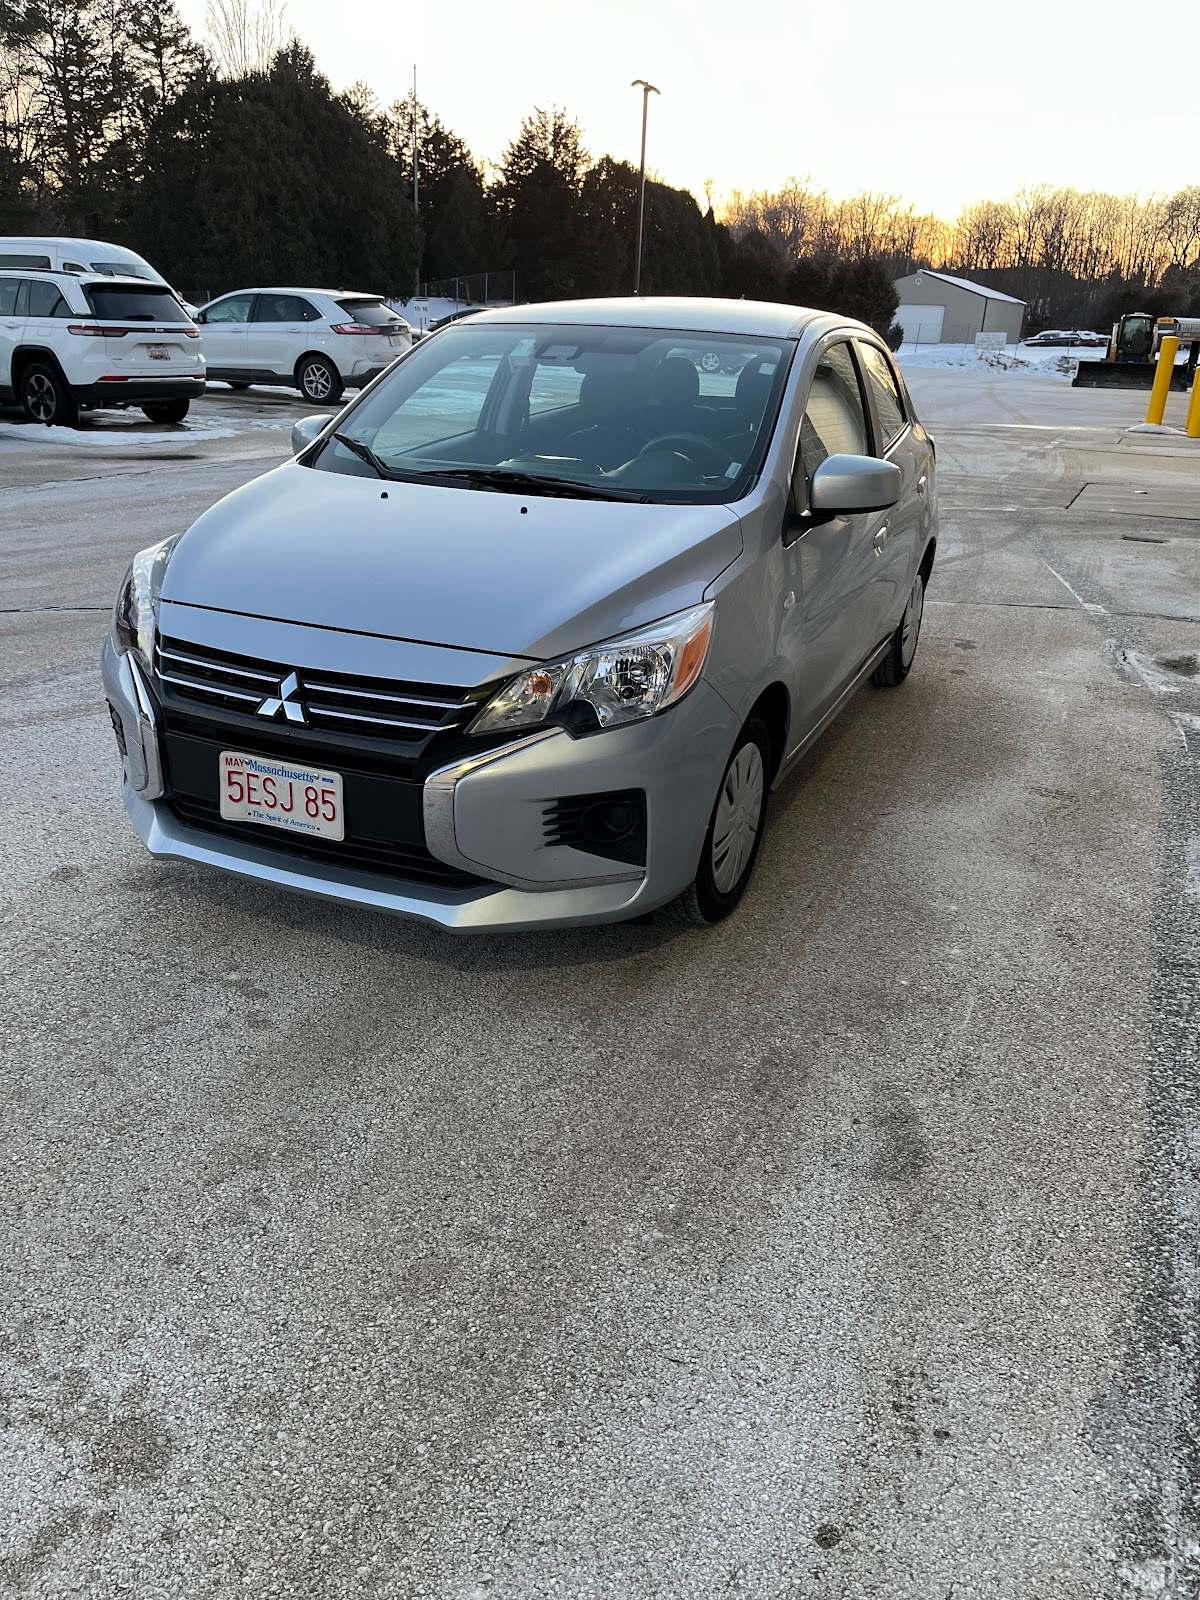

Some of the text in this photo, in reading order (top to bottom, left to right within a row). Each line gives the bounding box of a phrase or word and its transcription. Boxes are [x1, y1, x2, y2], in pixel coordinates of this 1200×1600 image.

[225, 757, 245, 767] MAY
[248, 760, 314, 783] Massachusetts
[227, 770, 336, 822] 5ESJ 85
[265, 813, 282, 823] Spirit
[290, 820, 316, 830] America
